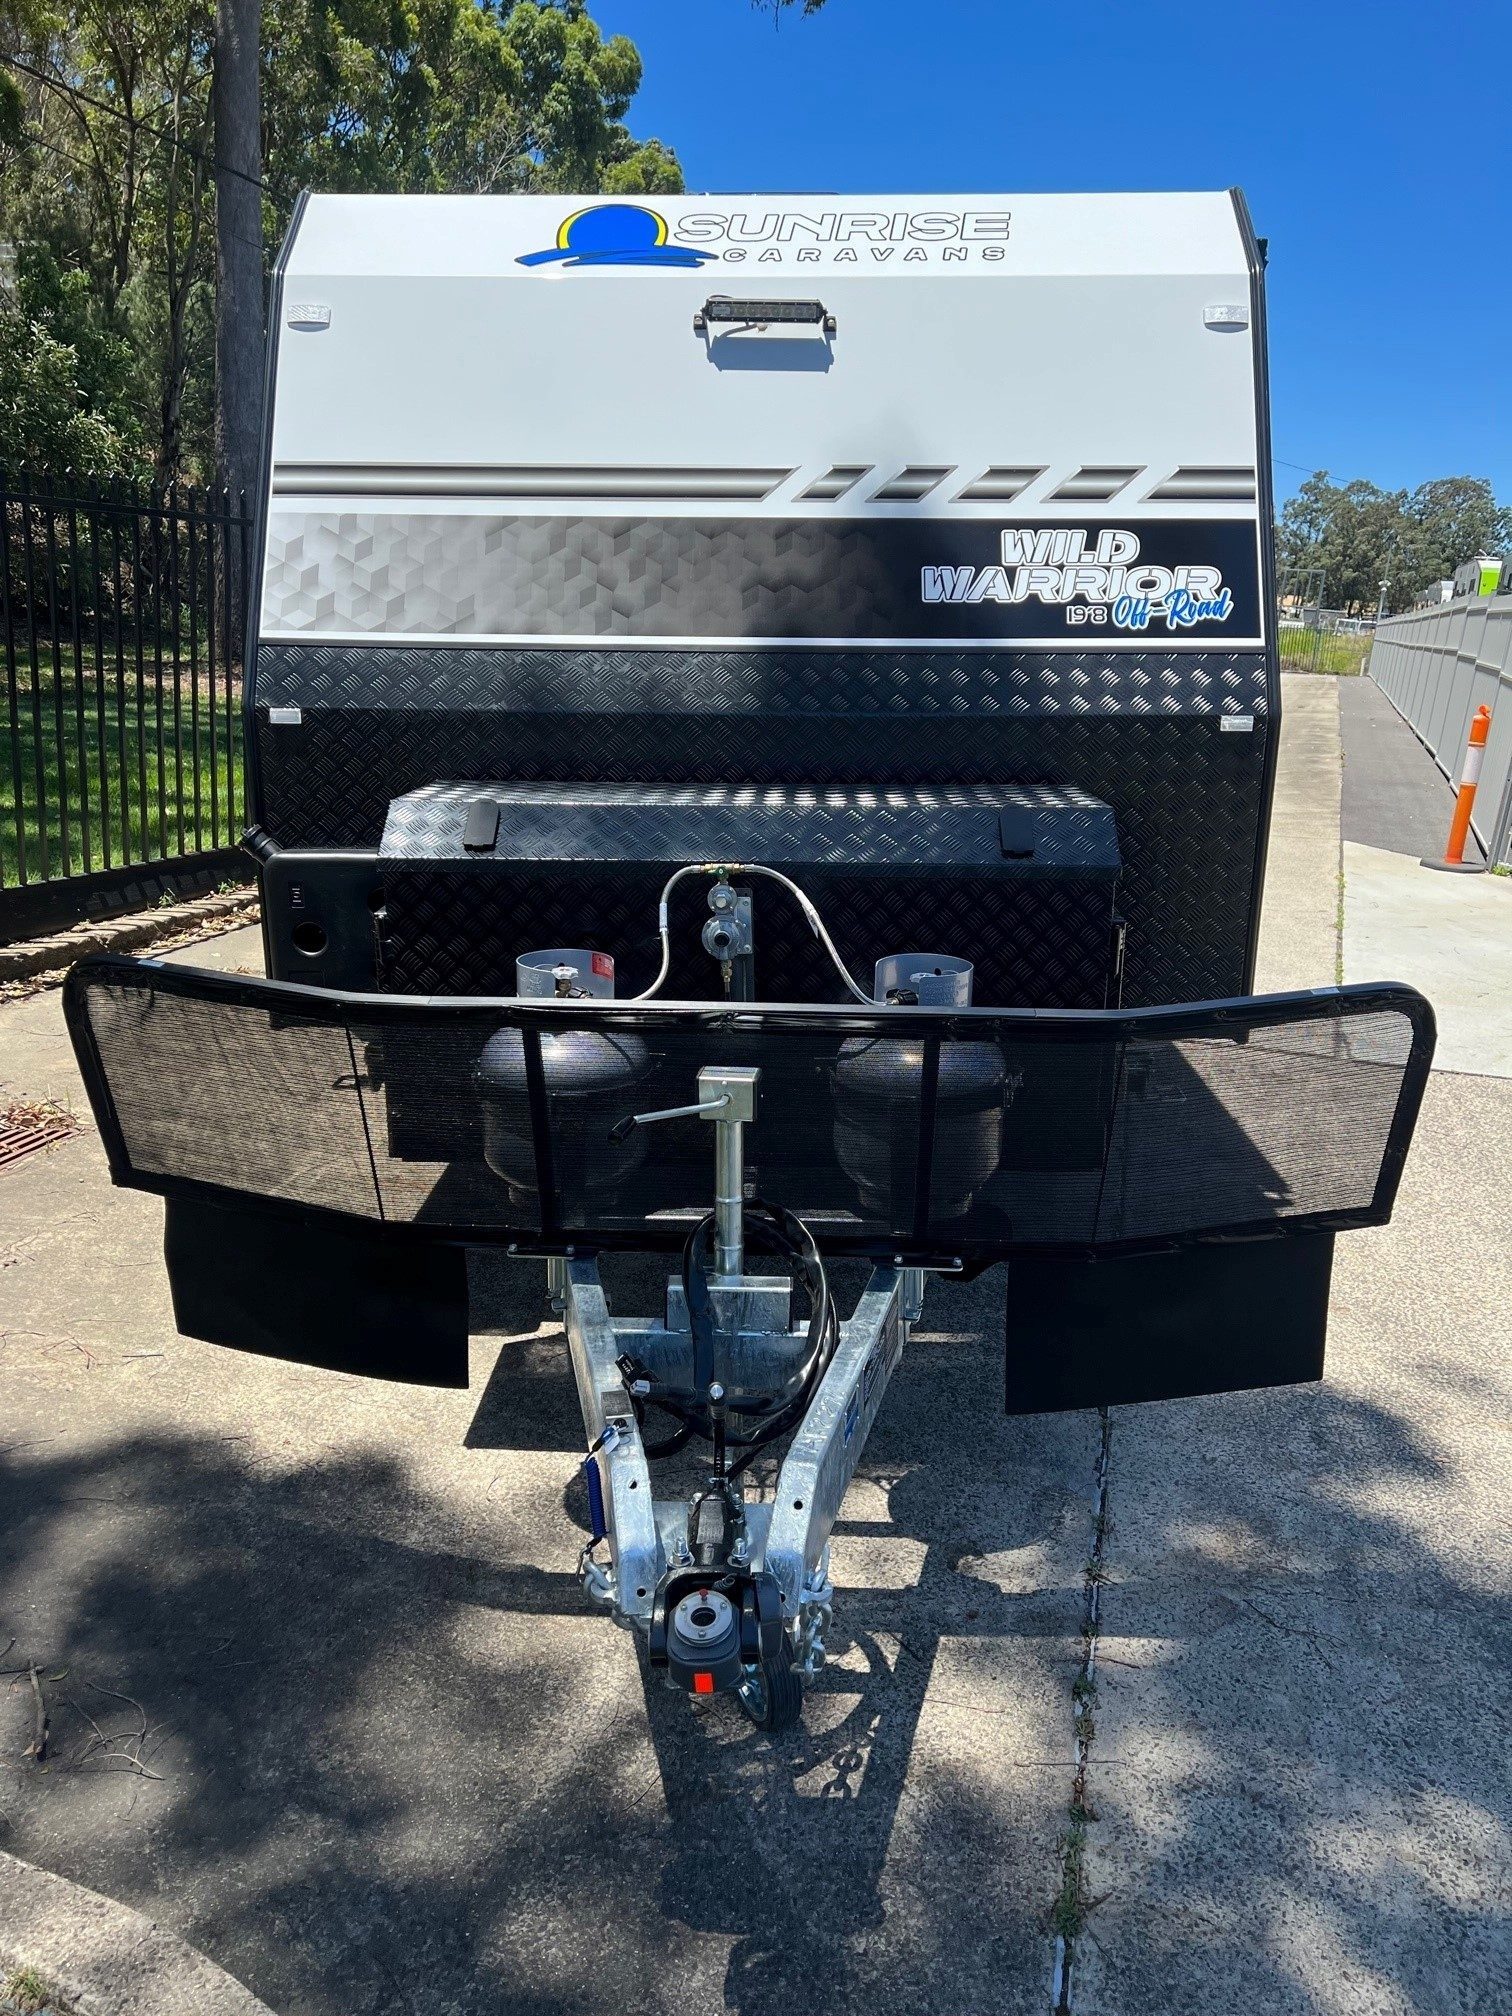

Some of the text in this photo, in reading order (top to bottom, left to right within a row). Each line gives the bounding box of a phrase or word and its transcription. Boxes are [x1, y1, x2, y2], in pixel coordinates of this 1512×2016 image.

[674, 212, 1011, 241] SUNRISE
[724, 247, 1006, 262] CARAVANS
[1001, 529, 1140, 565] WILD
[921, 566, 1223, 603] WARRIOR
[1113, 587, 1233, 630] Off-Road
